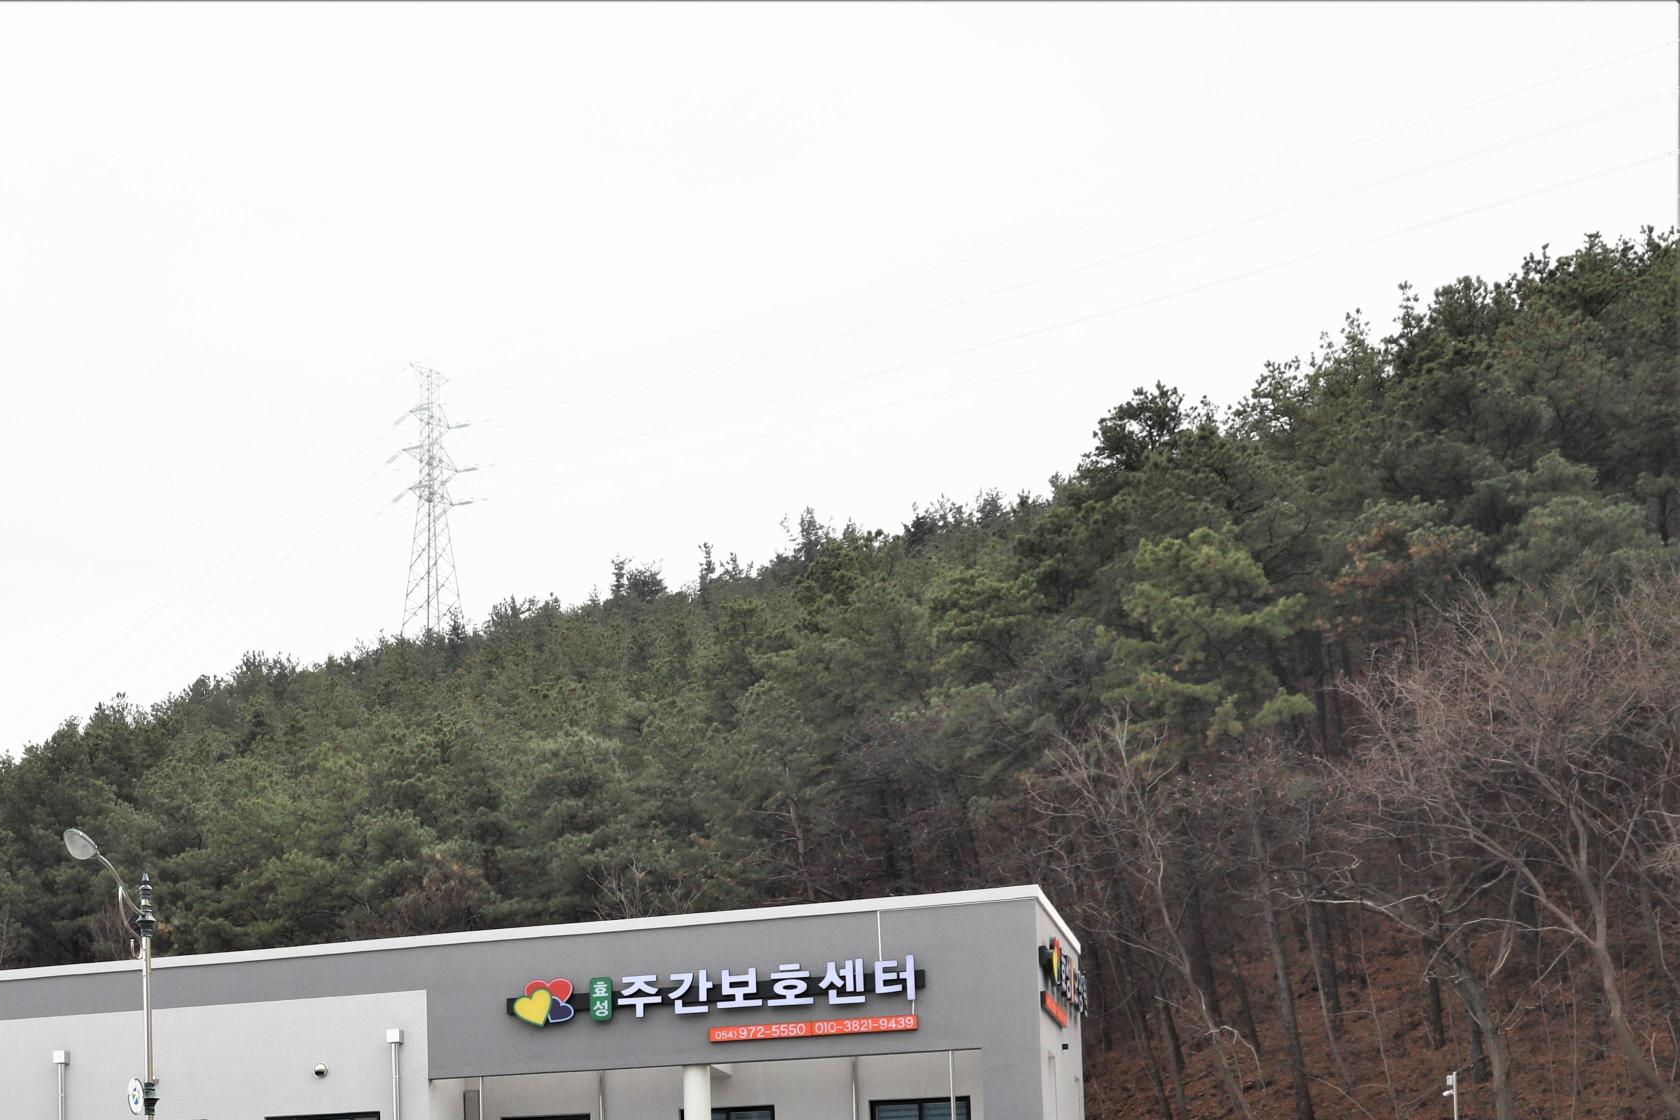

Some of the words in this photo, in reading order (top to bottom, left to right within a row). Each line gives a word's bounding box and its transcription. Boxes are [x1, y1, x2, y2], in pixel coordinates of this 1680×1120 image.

[592, 980, 610, 1018] 효성
[617, 954, 917, 1018] 주간보호센터
[814, 1016, 915, 1033] 010-3821-9439
